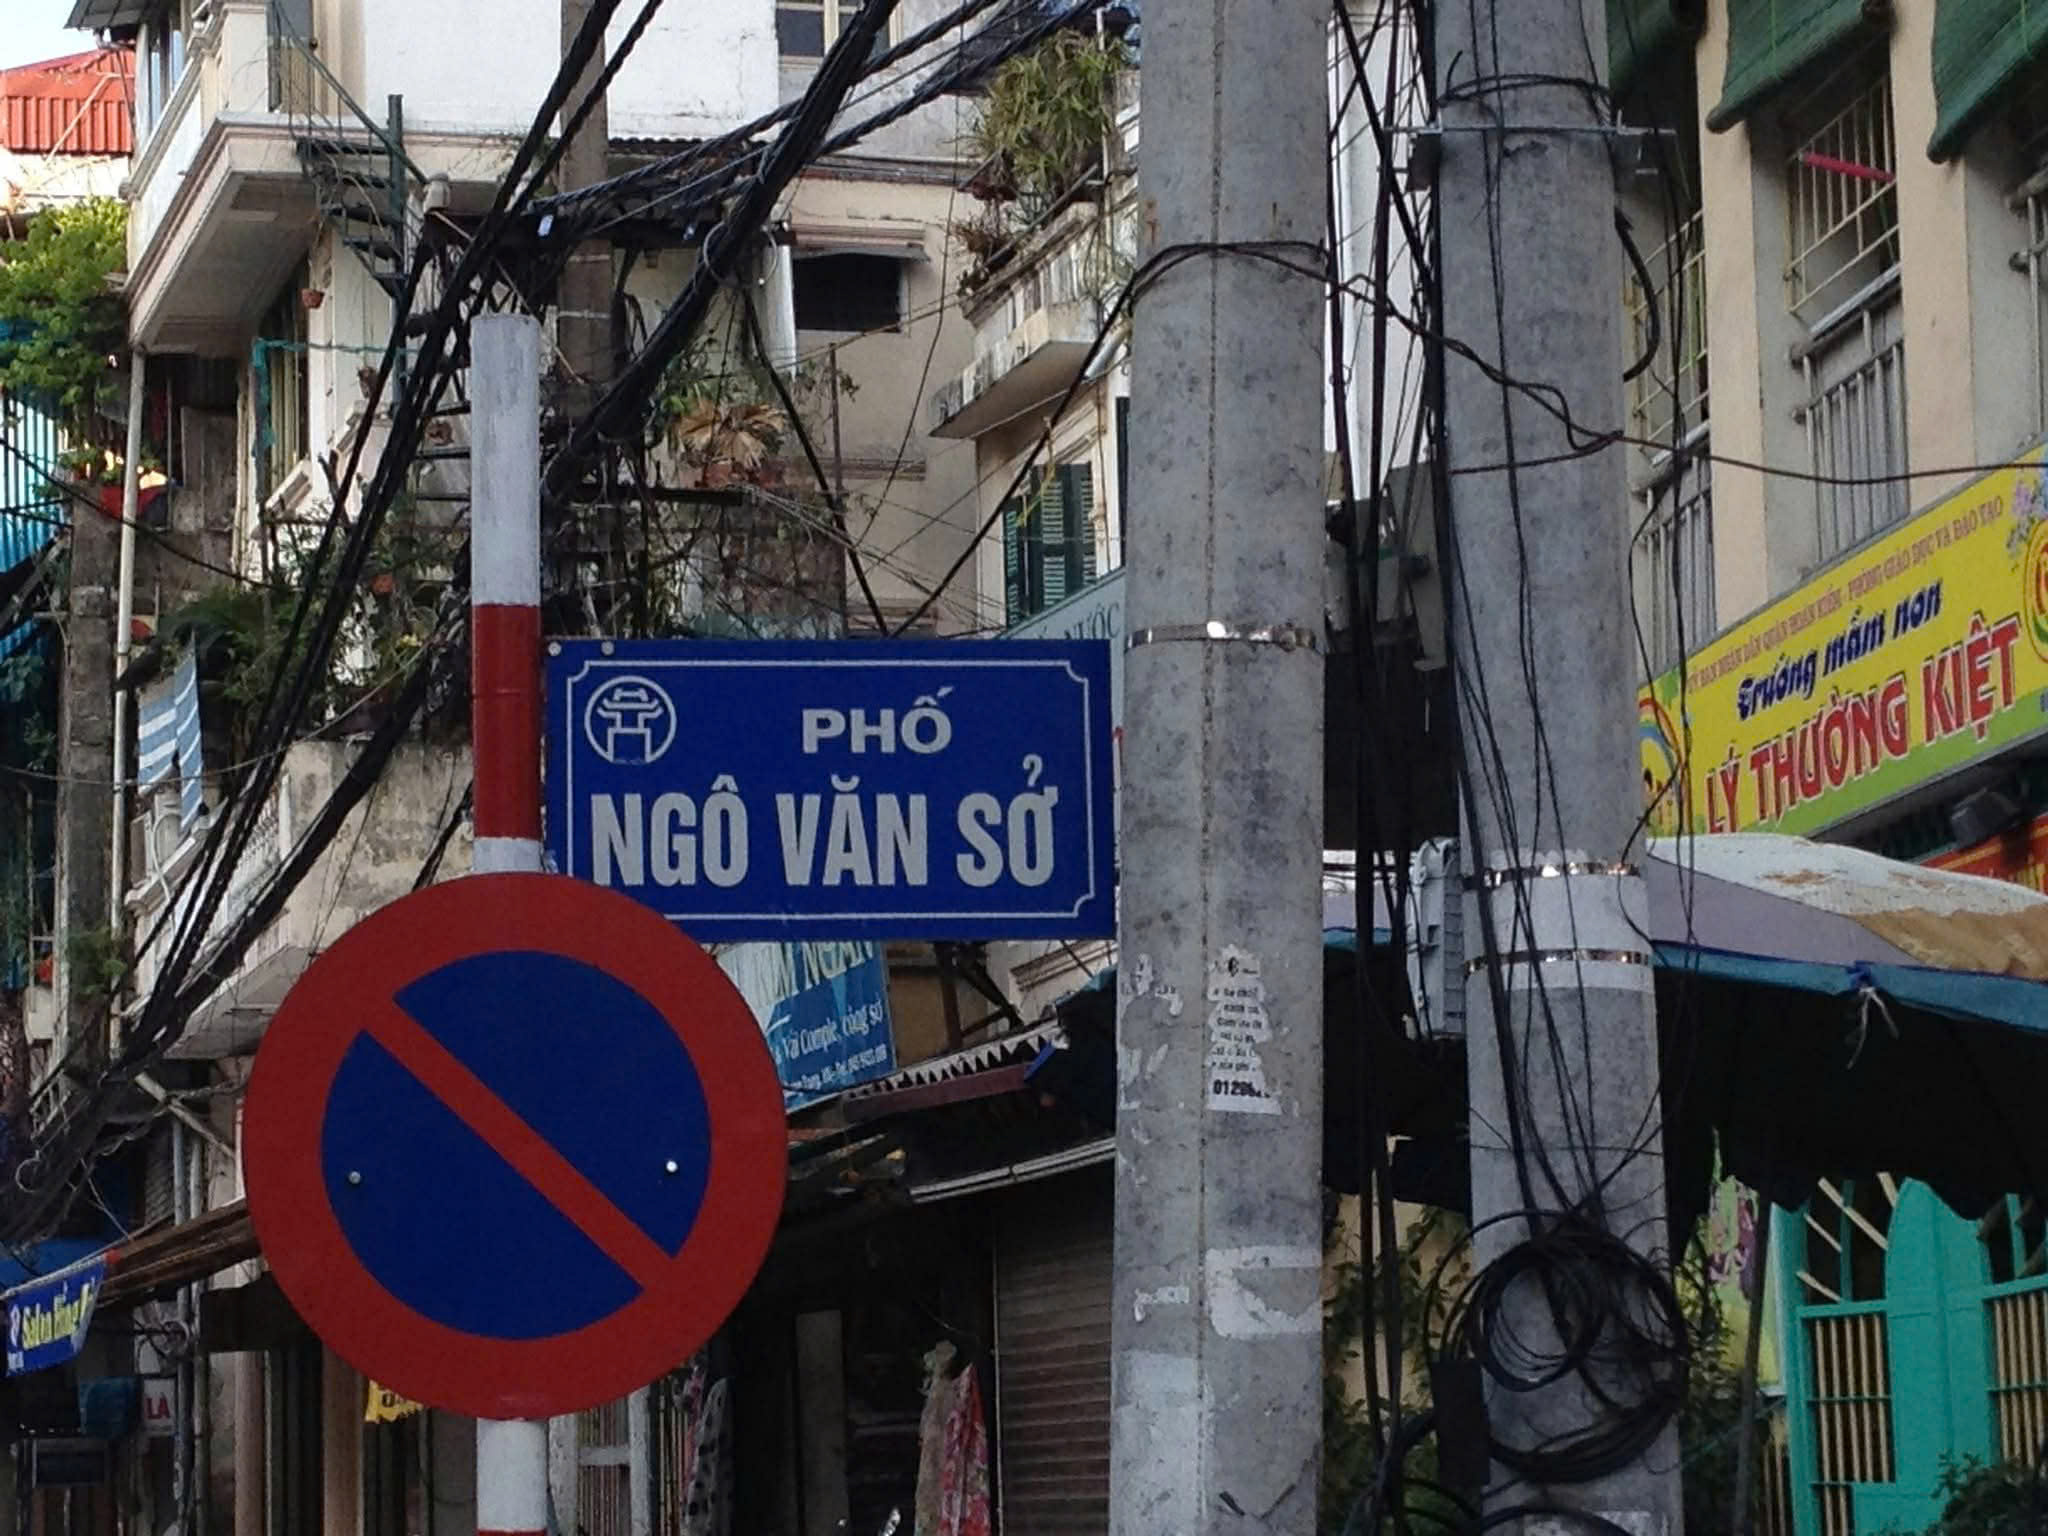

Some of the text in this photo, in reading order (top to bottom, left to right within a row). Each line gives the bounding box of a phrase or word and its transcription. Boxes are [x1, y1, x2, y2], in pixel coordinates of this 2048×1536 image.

[1892, 578, 1942, 639] non
[803, 686, 954, 754] PHỐ
[1704, 609, 2016, 834] LÝ THƯỜNG KIỆT
[591, 754, 1060, 888] NGÔ VĂN SỞ
